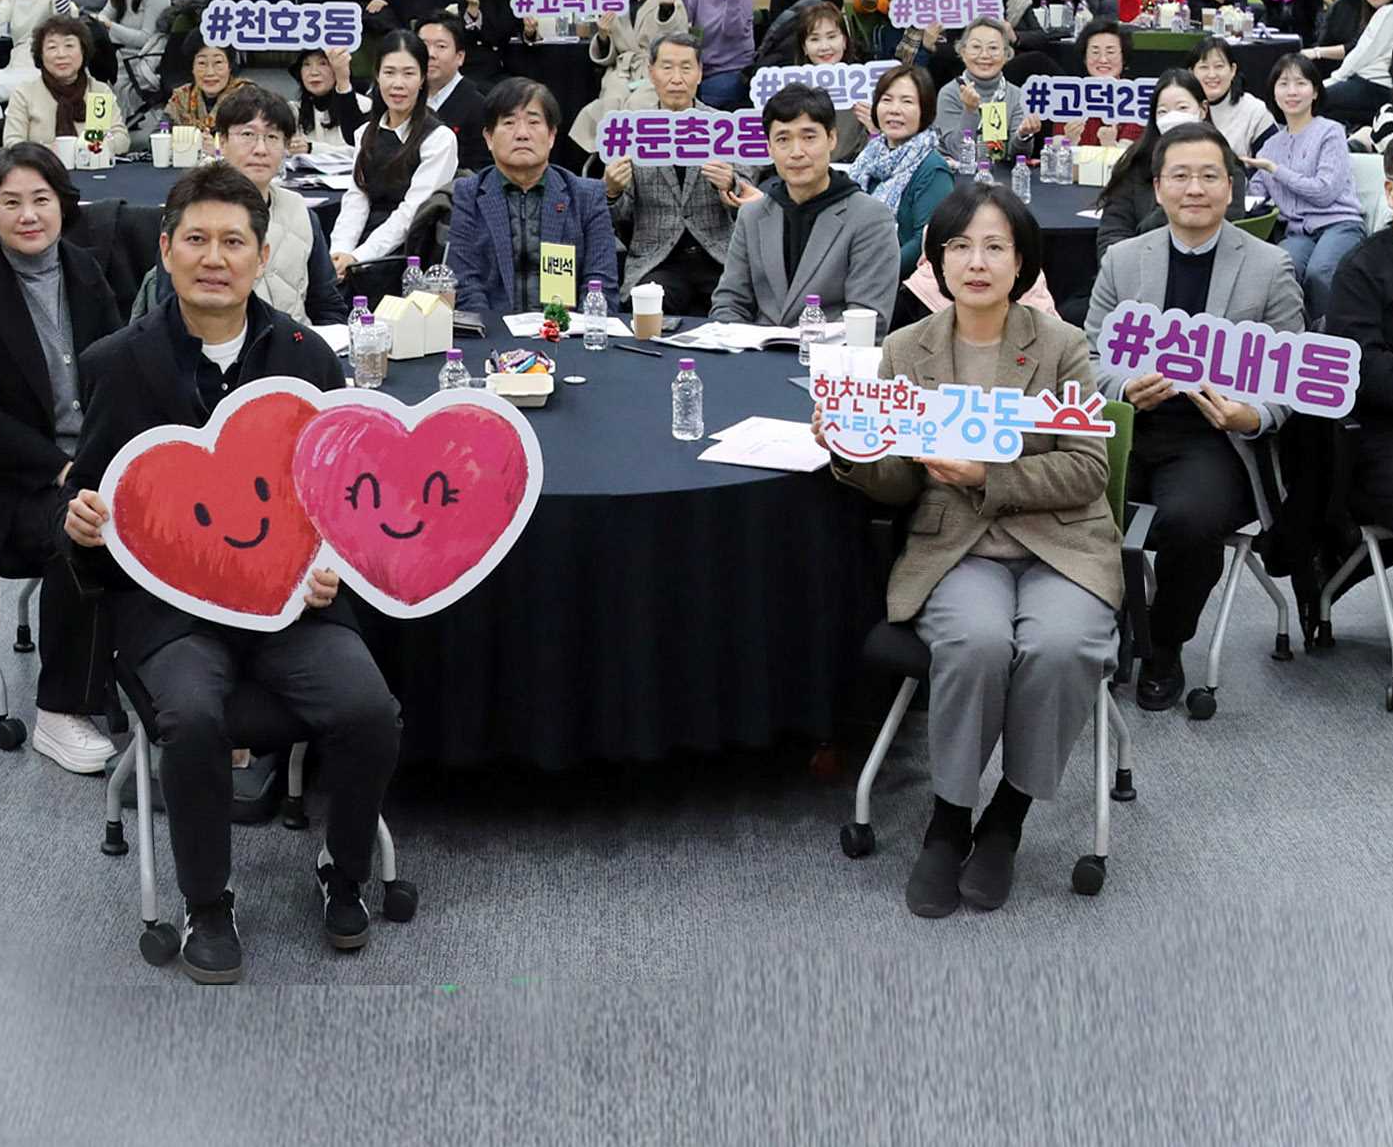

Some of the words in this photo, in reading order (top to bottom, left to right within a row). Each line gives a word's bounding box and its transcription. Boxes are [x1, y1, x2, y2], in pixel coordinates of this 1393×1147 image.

[206, 6, 357, 46] #천호3동
[603, 116, 770, 159] #둔촌2동
[542, 255, 574, 276] 내빈석
[1108, 311, 1352, 408] #성내1동
[940, 388, 1035, 454] 강동
